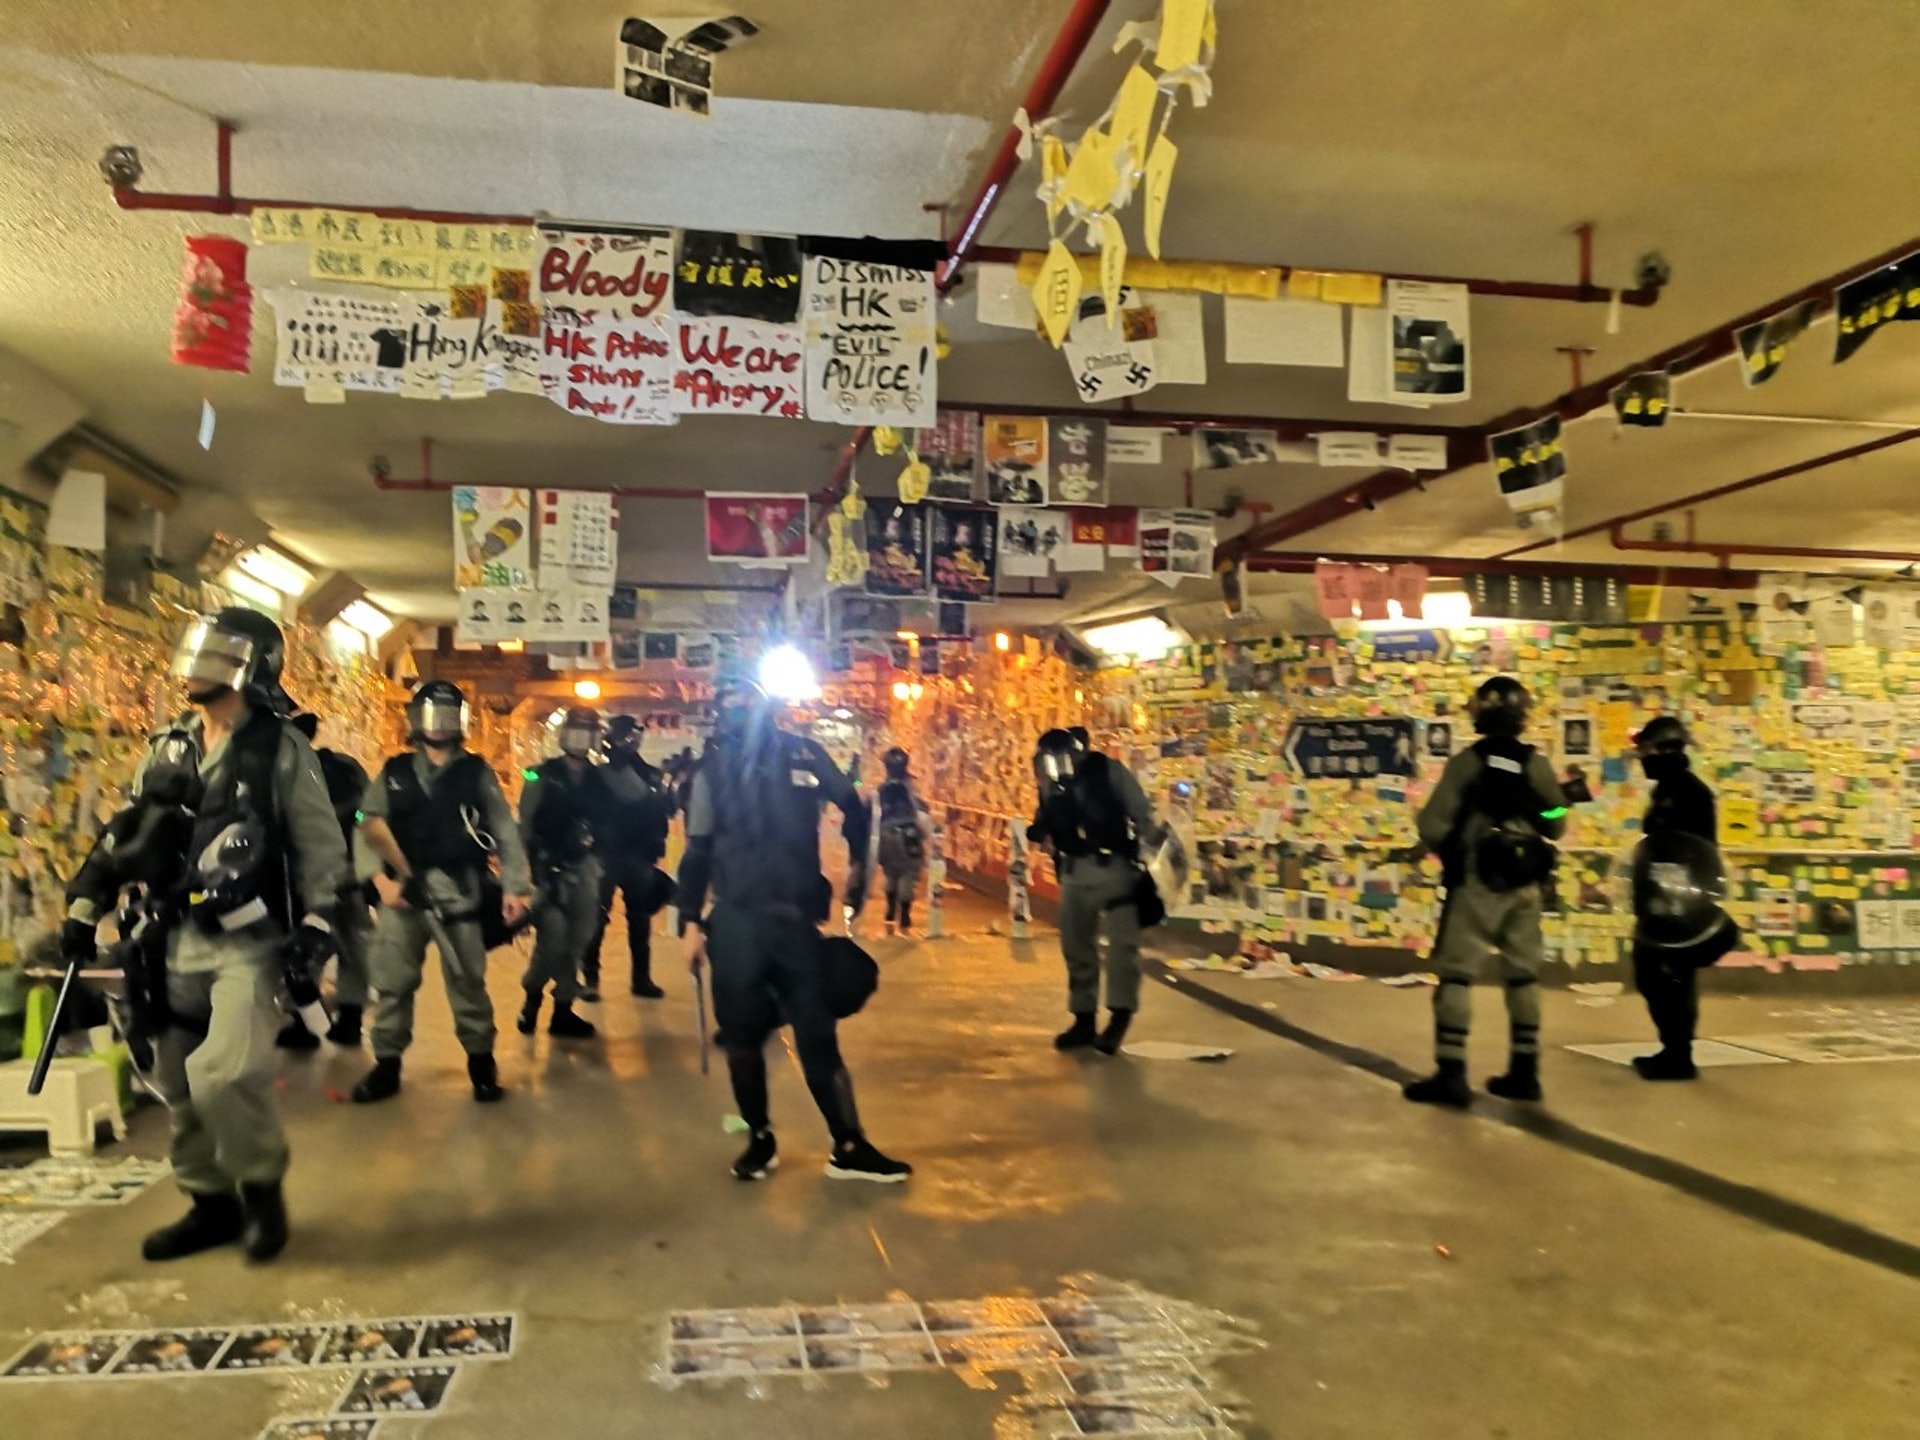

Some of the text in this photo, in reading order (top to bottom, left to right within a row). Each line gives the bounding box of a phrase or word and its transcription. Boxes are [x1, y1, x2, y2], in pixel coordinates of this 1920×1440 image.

[541, 247, 669, 317] Bloody
[841, 286, 892, 318] HK
[545, 326, 597, 361] HK
[679, 323, 801, 374] We are
[833, 335, 891, 354] EVIL
[690, 368, 785, 414] Angry
